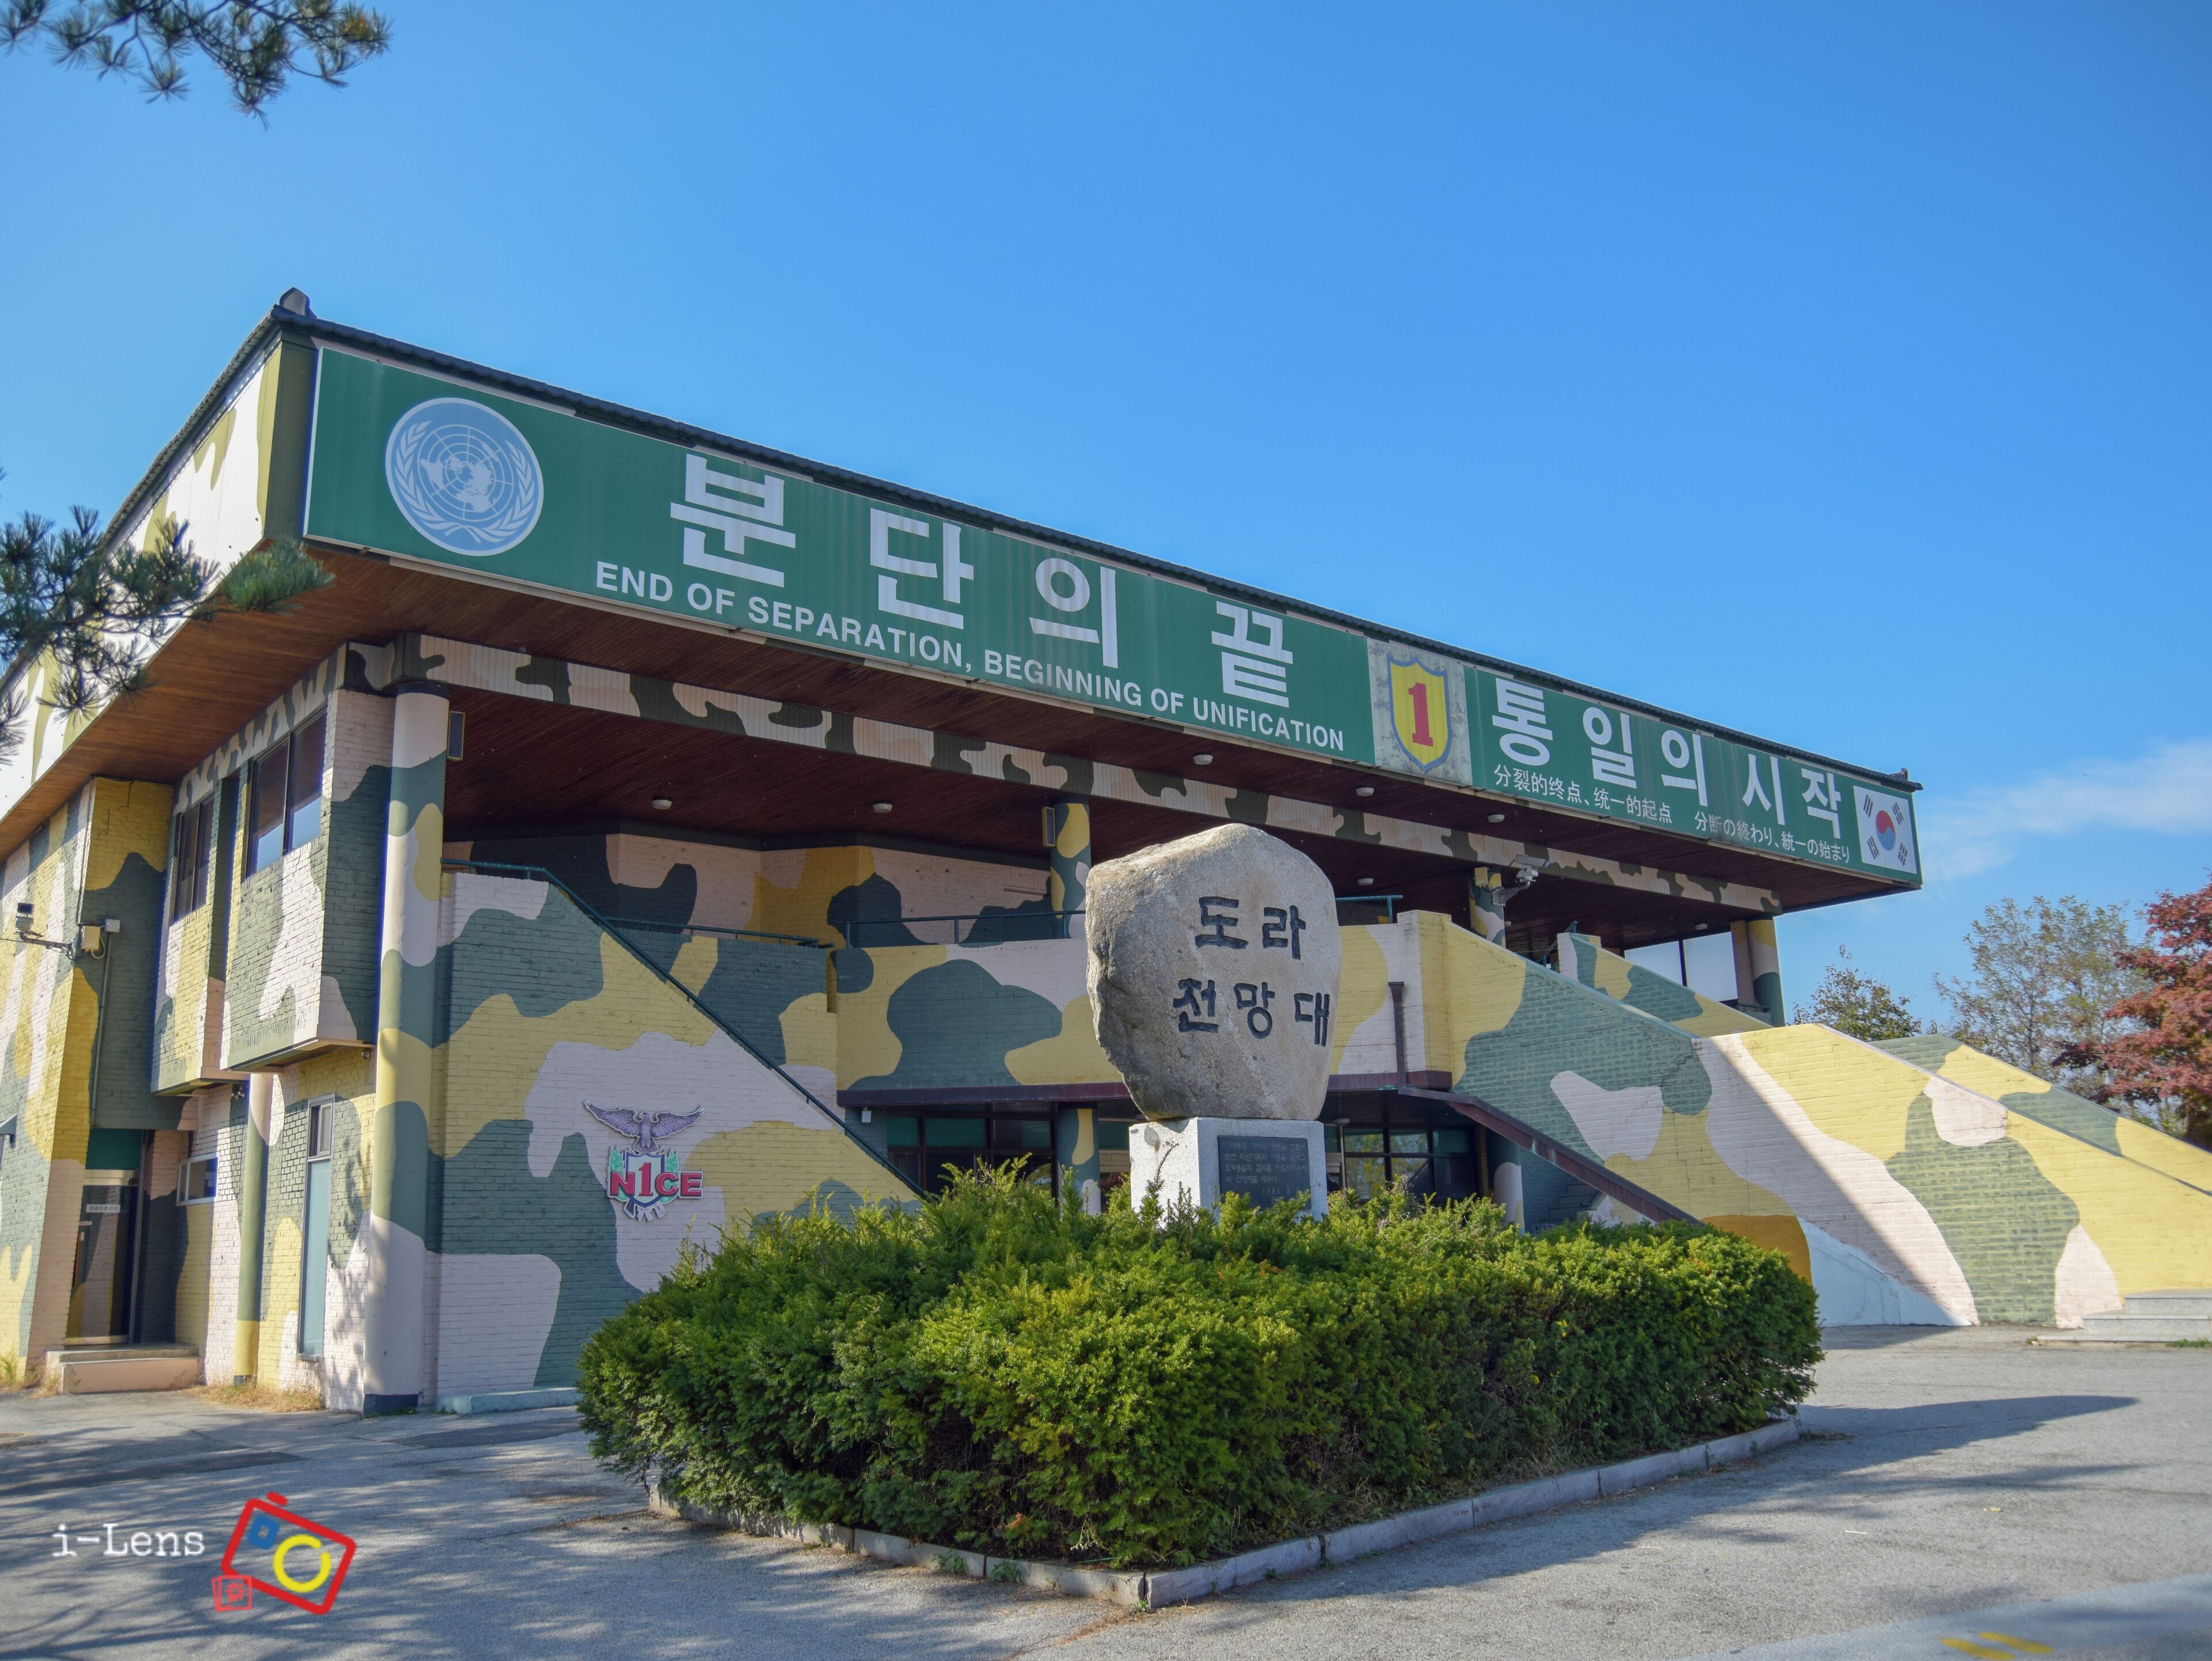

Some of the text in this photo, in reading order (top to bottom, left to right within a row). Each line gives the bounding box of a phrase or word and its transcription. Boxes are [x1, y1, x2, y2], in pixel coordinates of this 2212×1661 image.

[671, 453, 1293, 708] 분단의 끝
[597, 561, 1343, 751] END OF SEPARATION, BEGINNING OF UNIFICATION
[1408, 682, 1433, 747] 1
[1492, 678, 1841, 839] 통일의 시작
[1195, 896, 1306, 960] 도라
[1172, 978, 1330, 1047] 전망대
